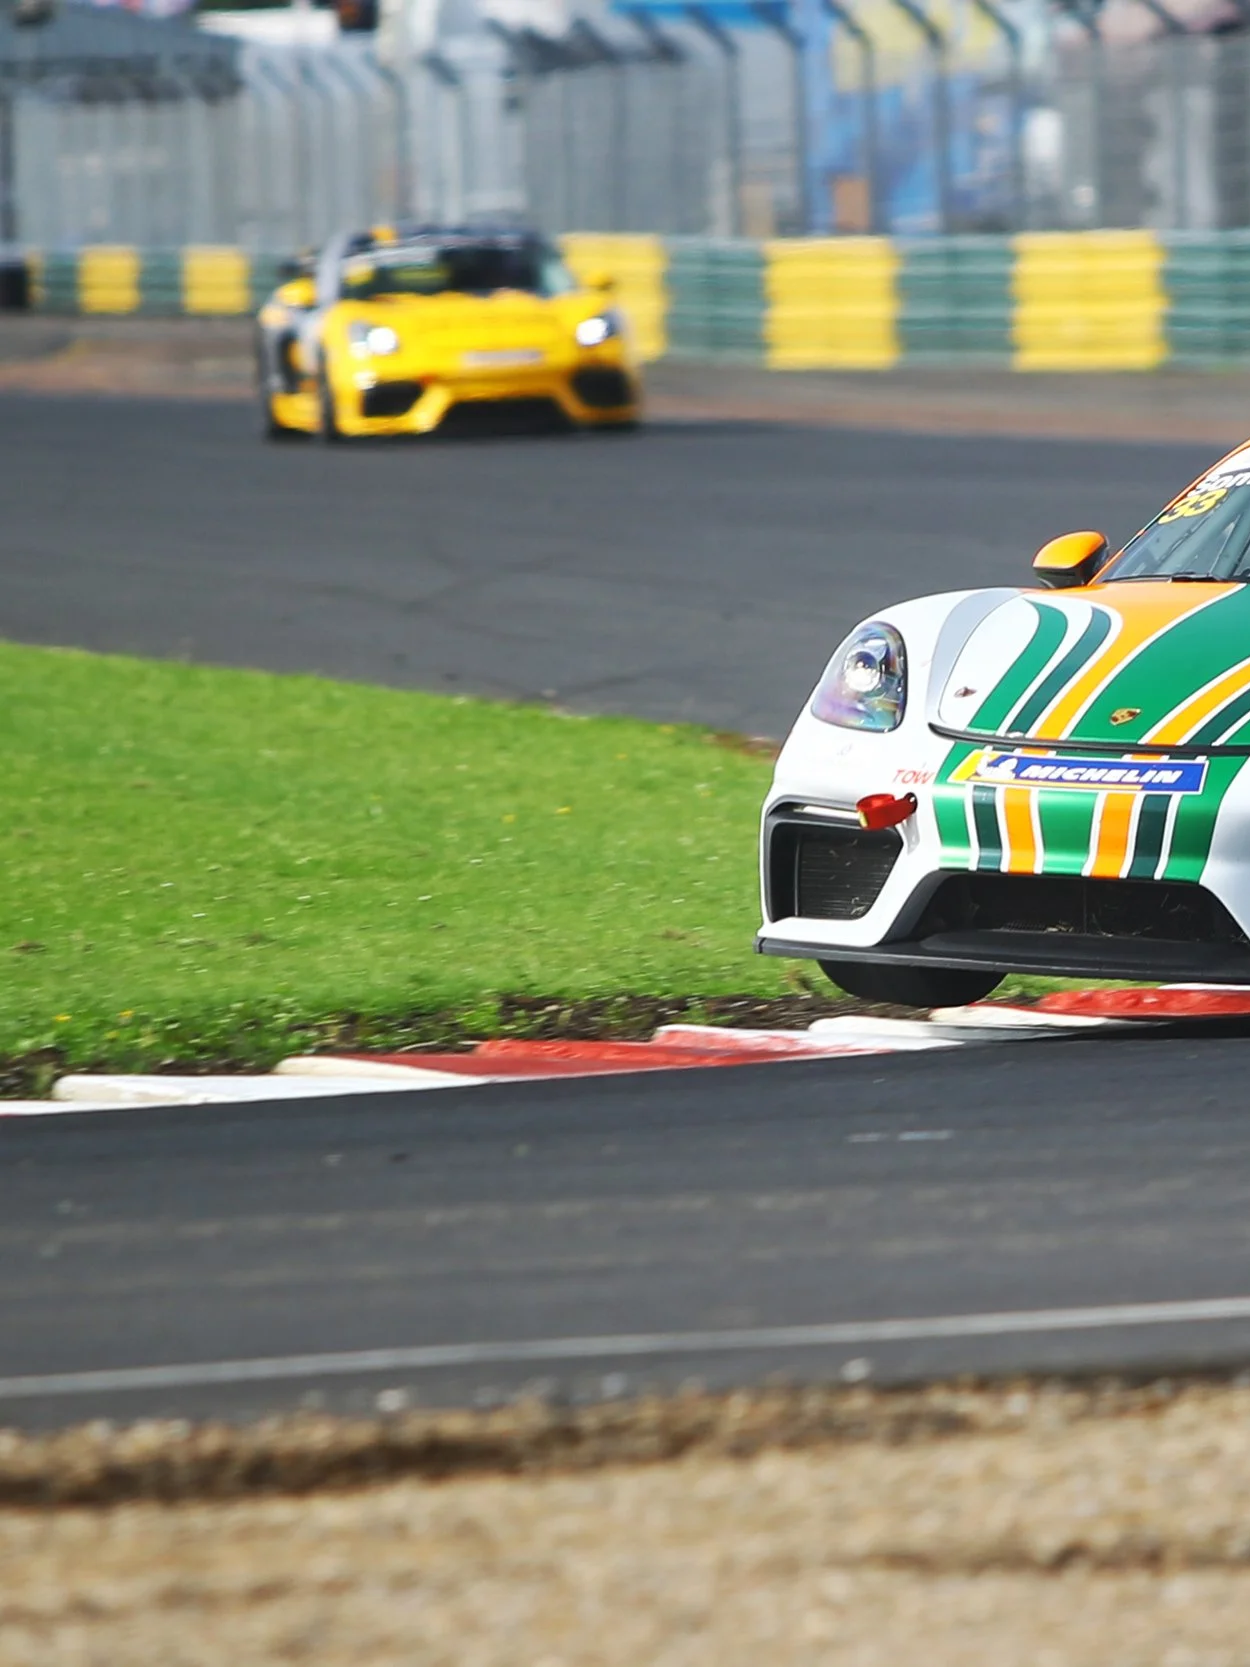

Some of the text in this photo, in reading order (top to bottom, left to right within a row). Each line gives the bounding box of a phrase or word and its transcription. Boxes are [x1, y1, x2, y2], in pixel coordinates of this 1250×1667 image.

[1158, 488, 1228, 525] 33
[892, 769, 936, 785] TOW
[1019, 764, 1183, 784] MICHELIN
